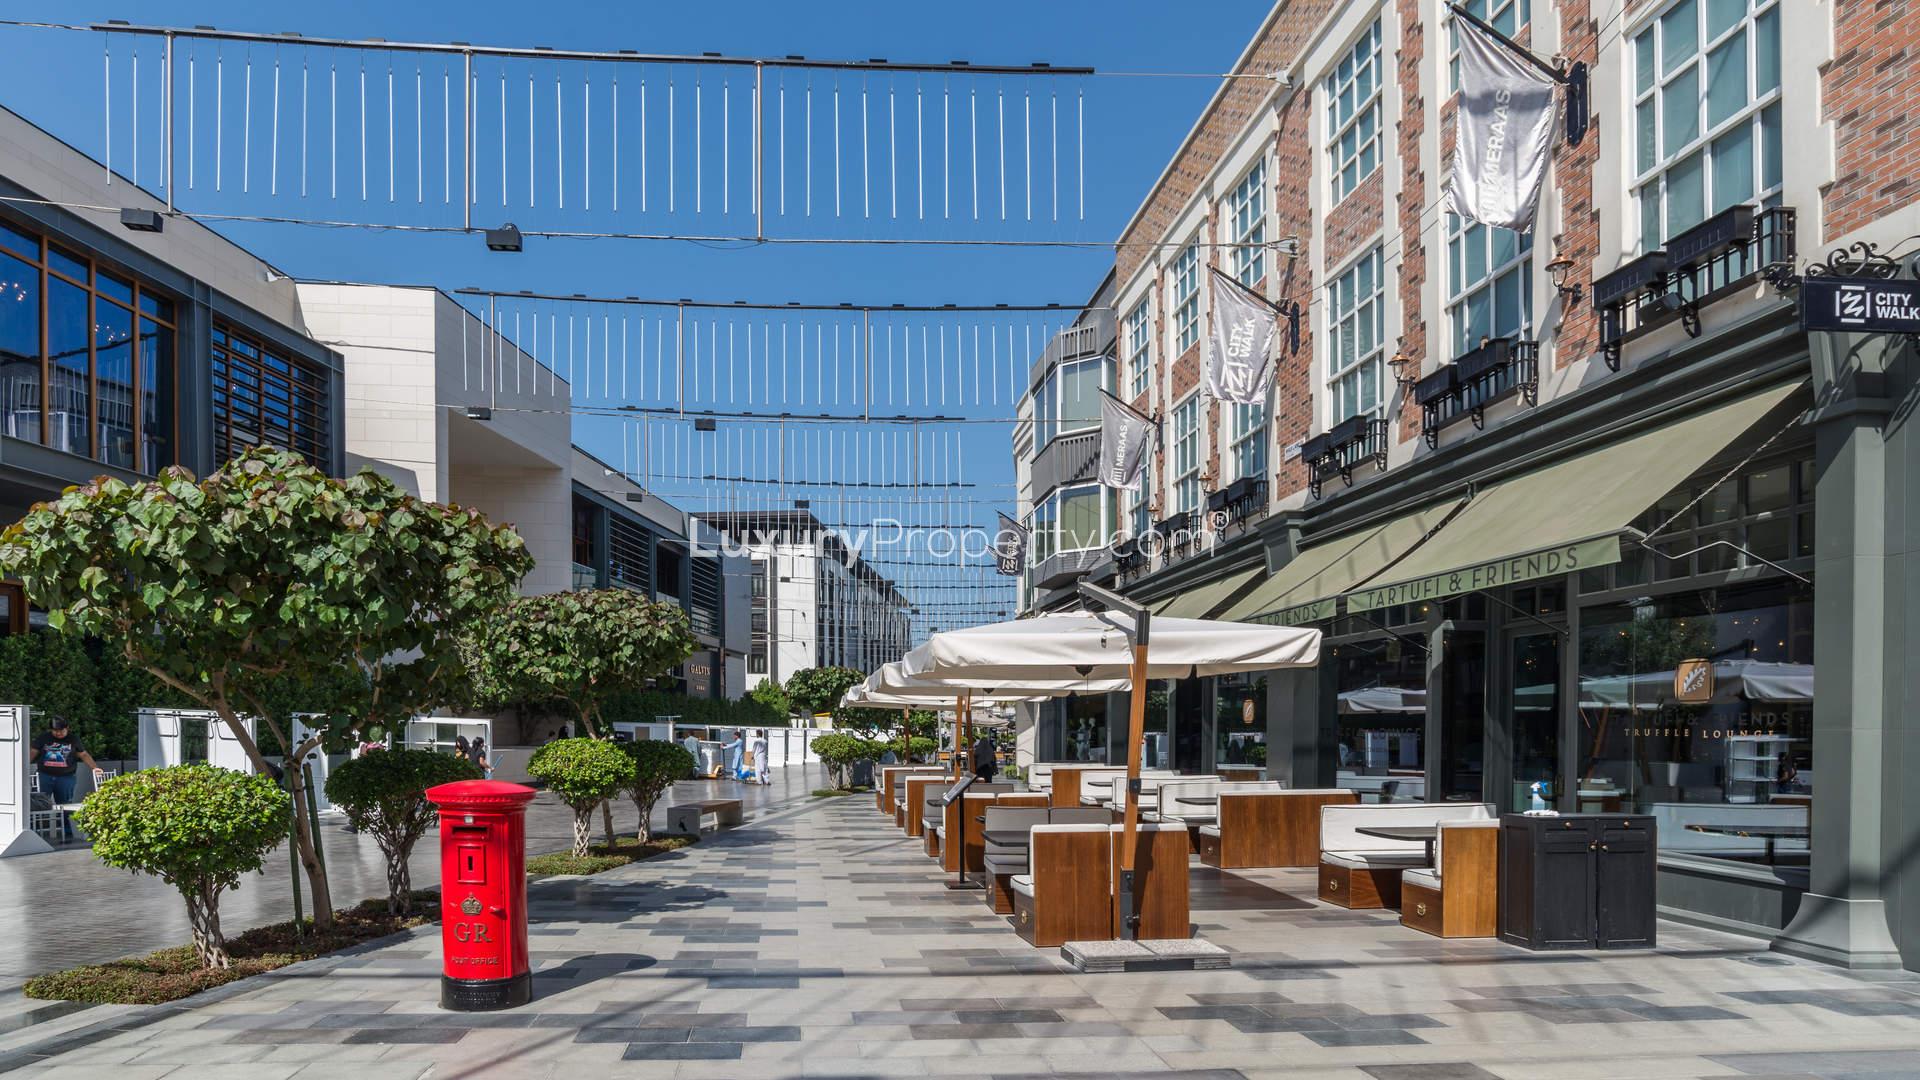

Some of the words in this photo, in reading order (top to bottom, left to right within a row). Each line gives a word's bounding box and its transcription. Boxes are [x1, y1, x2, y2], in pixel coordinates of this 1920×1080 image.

[1482, 89, 1511, 184] MERAAS
[1875, 292, 1911, 306] CITY
[1875, 305, 1920, 320] WALK
[1227, 322, 1244, 357] CITY
[1239, 318, 1256, 358] WALK
[1117, 424, 1128, 467] MERAAS
[1368, 577, 1439, 608] TARTUFI
[1449, 572, 1462, 592] &
[1472, 547, 1577, 588] FRIENDS
[1687, 712, 1698, 726] &
[1624, 728, 1690, 737] TRUFFLE
[1703, 729, 1774, 739] LOUNGE
[454, 922, 493, 943] GR
